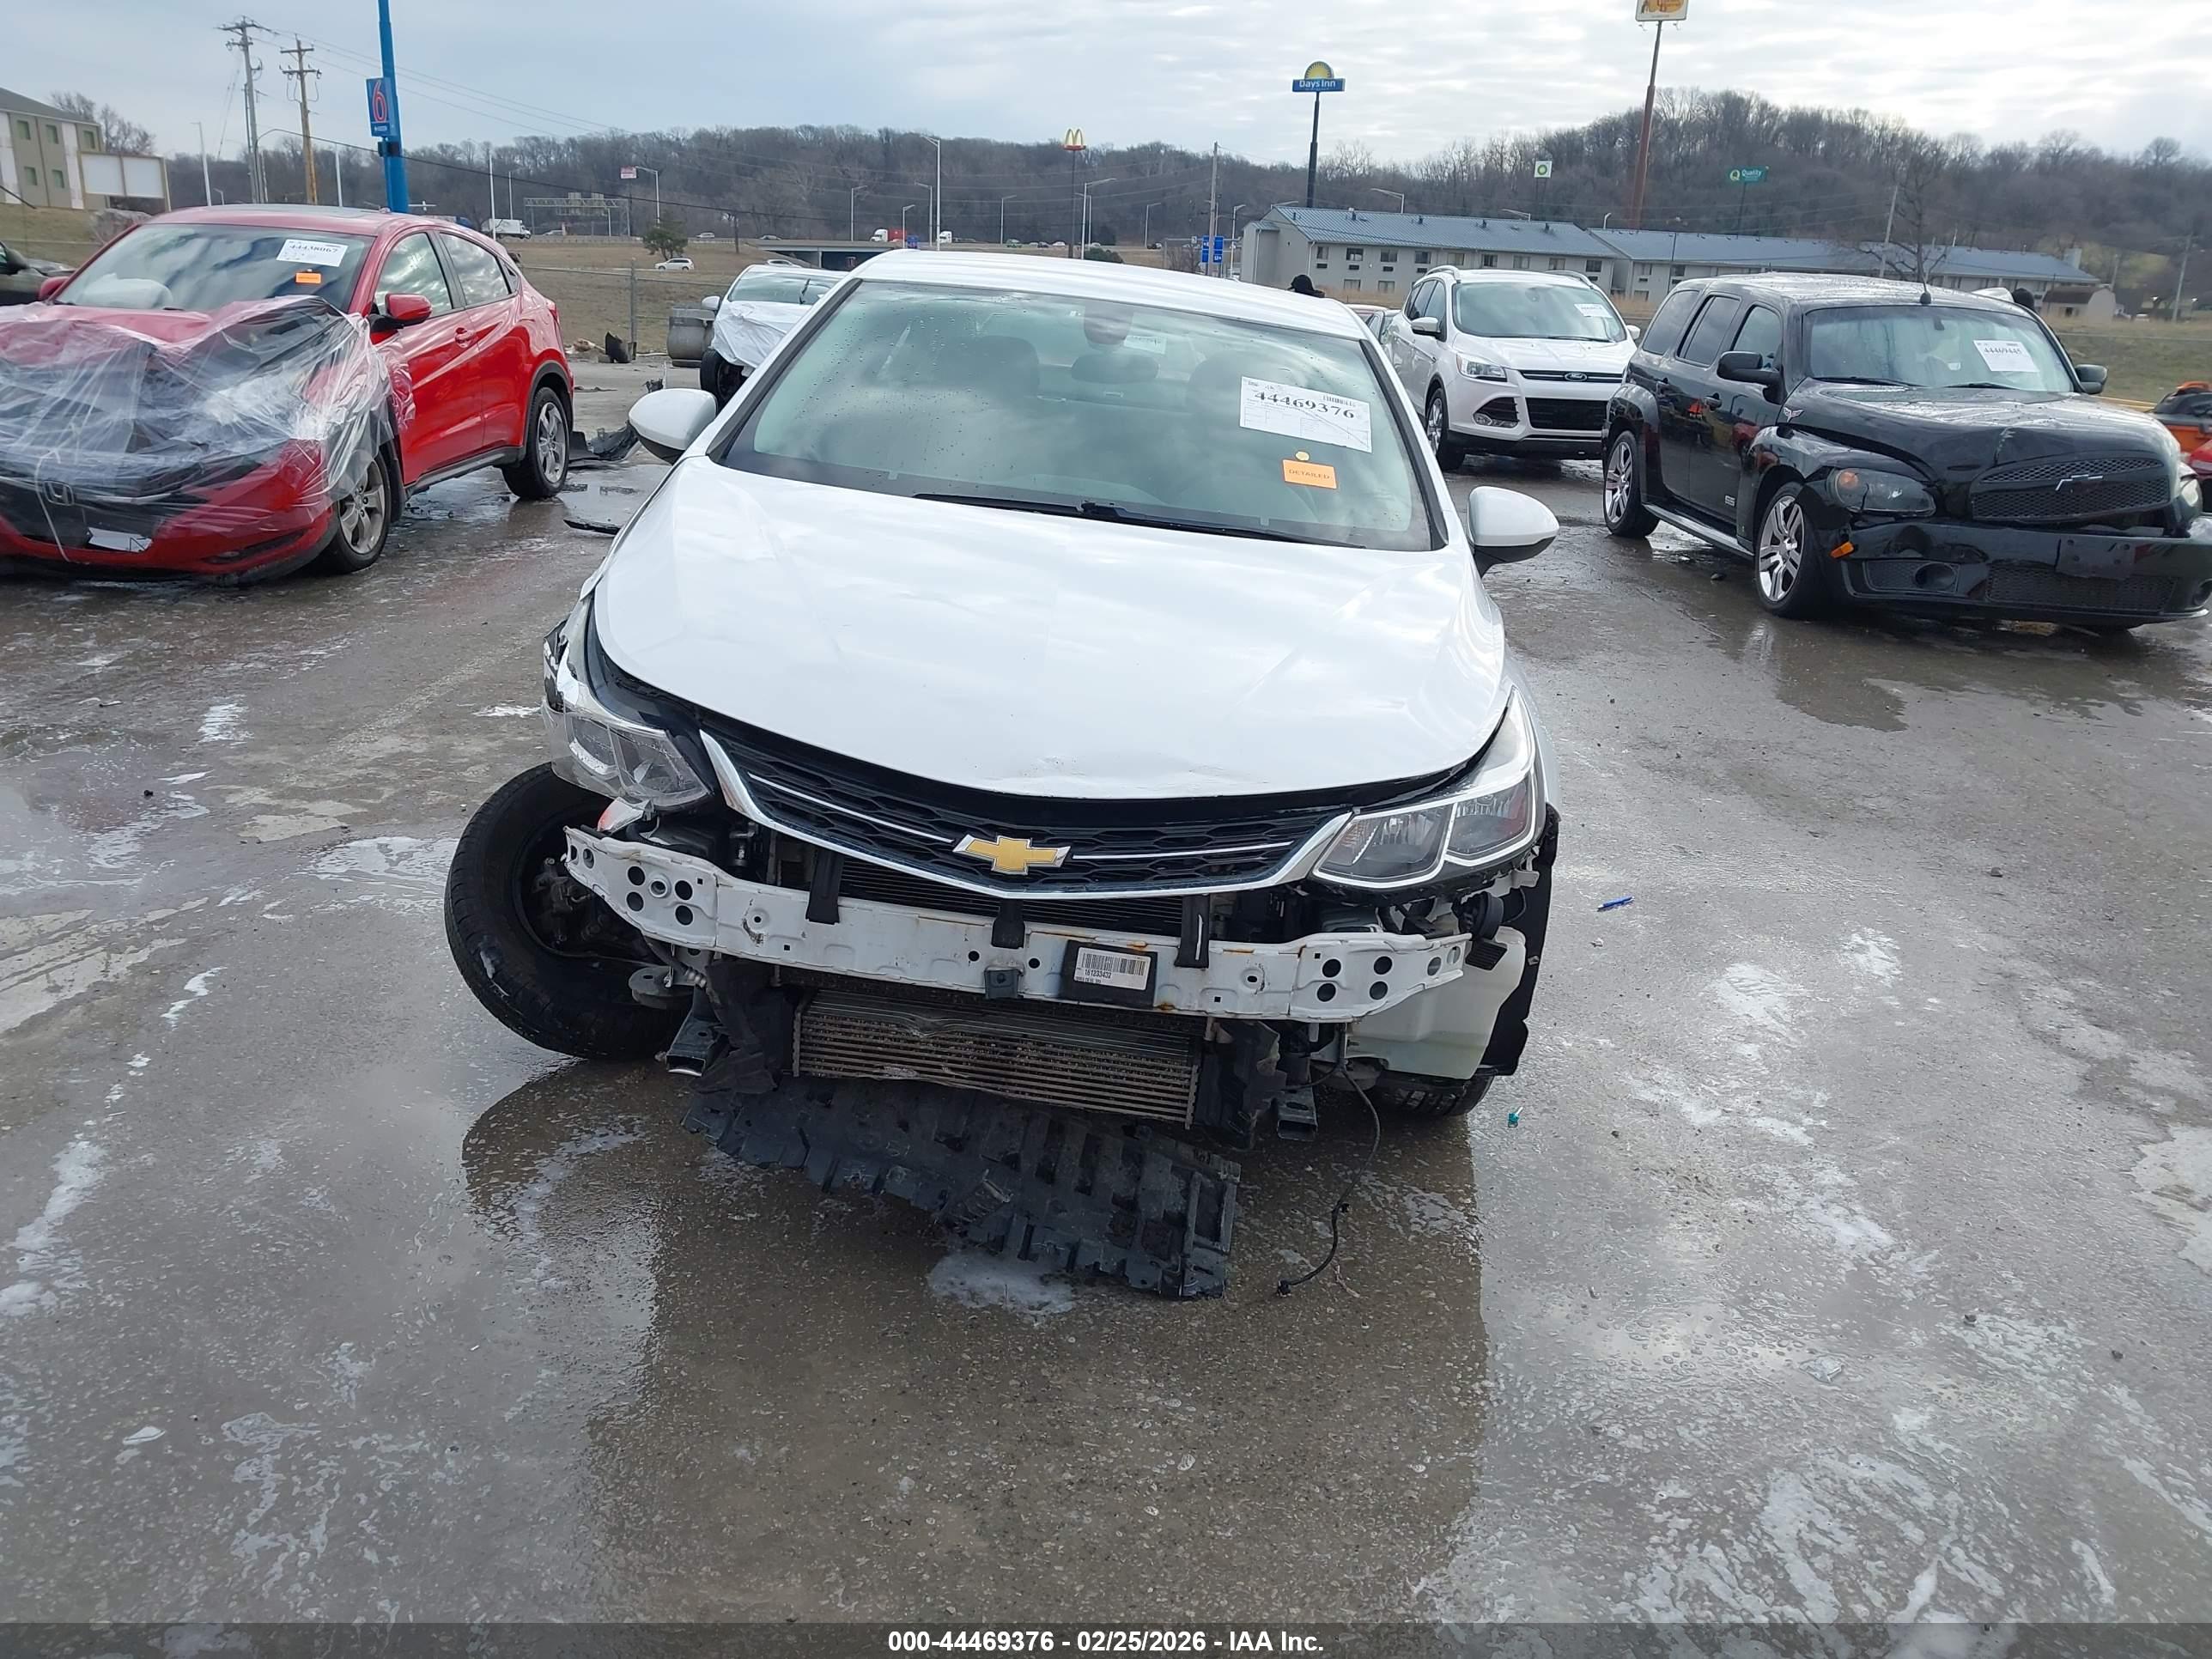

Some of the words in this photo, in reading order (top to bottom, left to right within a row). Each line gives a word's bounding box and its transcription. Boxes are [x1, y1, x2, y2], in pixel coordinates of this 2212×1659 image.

[1298, 80, 1320, 88] Days
[372, 82, 387, 123] 6
[1254, 391, 1355, 419] 44469376
[1288, 468, 1331, 480] DETAILED
